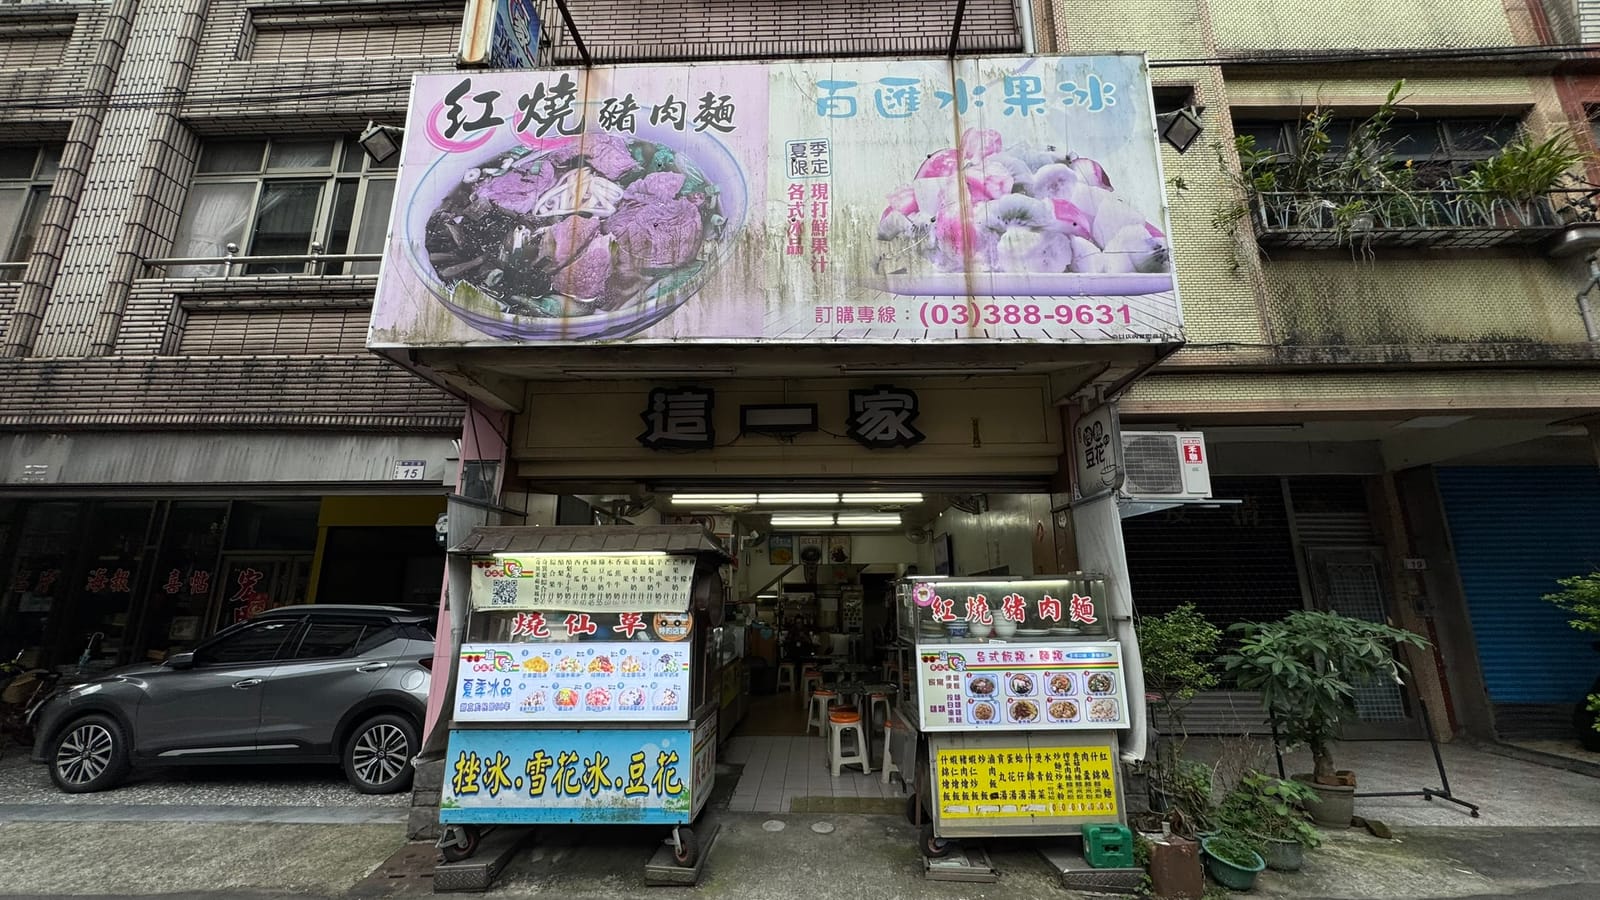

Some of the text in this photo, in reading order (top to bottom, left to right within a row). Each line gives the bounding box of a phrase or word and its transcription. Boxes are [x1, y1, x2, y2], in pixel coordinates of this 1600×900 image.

[443, 73, 737, 142] 紅燒豬肉麵
[815, 75, 1116, 120] 百匯水果冰
[786, 184, 804, 256] 各式冰品
[810, 183, 828, 273] 現打鮮果汁
[919, 301, 1132, 328] (03)388-9631
[637, 384, 925, 449] 這一家
[404, 469, 419, 479] 15
[931, 593, 1098, 625] 紅燒豬肉麵
[462, 678, 513, 698] 夏季冰品
